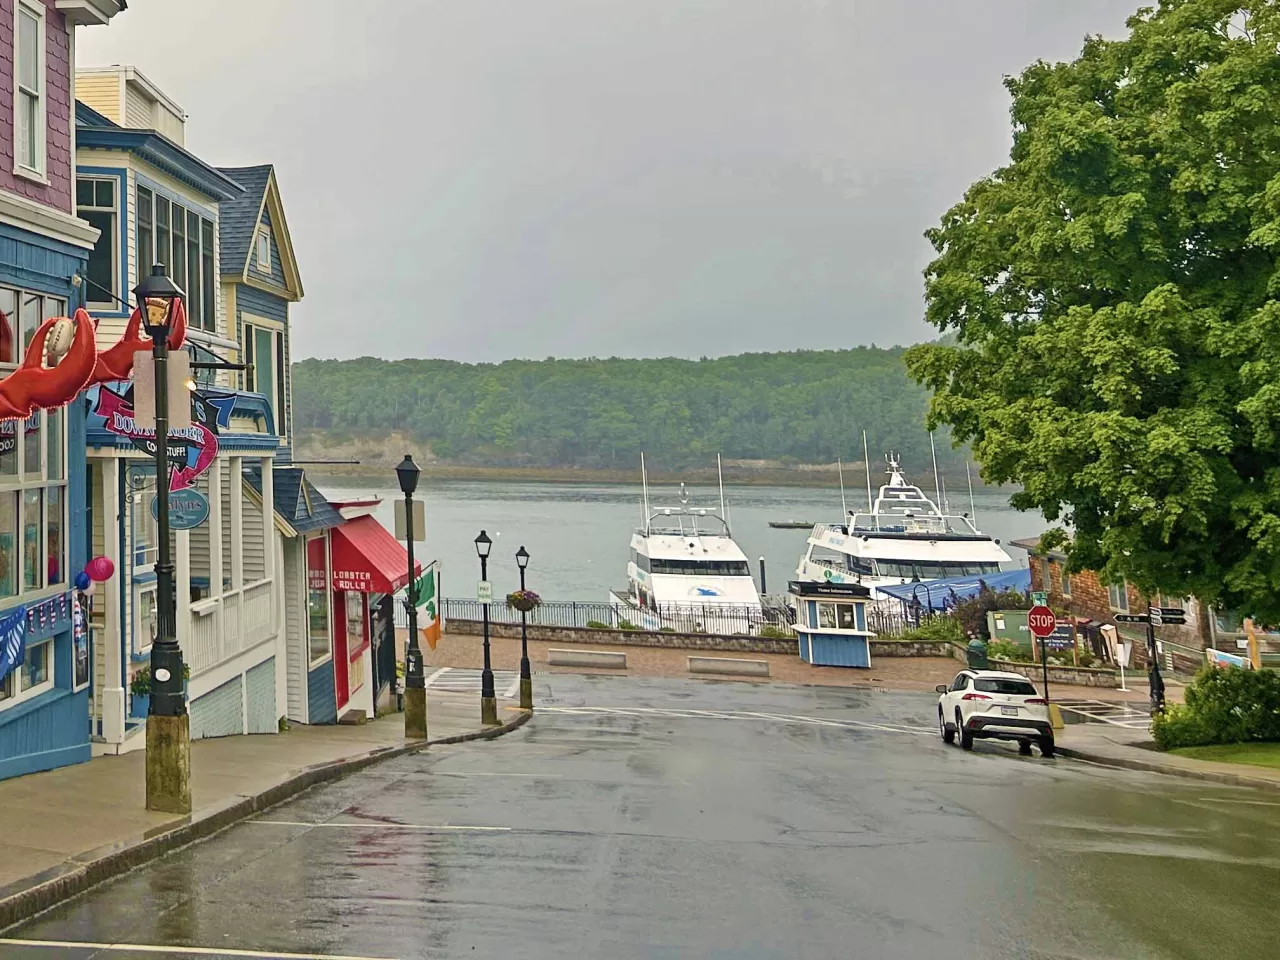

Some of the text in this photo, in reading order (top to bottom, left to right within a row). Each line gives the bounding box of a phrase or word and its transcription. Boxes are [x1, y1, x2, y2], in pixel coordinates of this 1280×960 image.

[333, 571, 371, 580] LOBSTER
[339, 580, 366, 590] ROLLS
[1030, 615, 1054, 627] STOP
